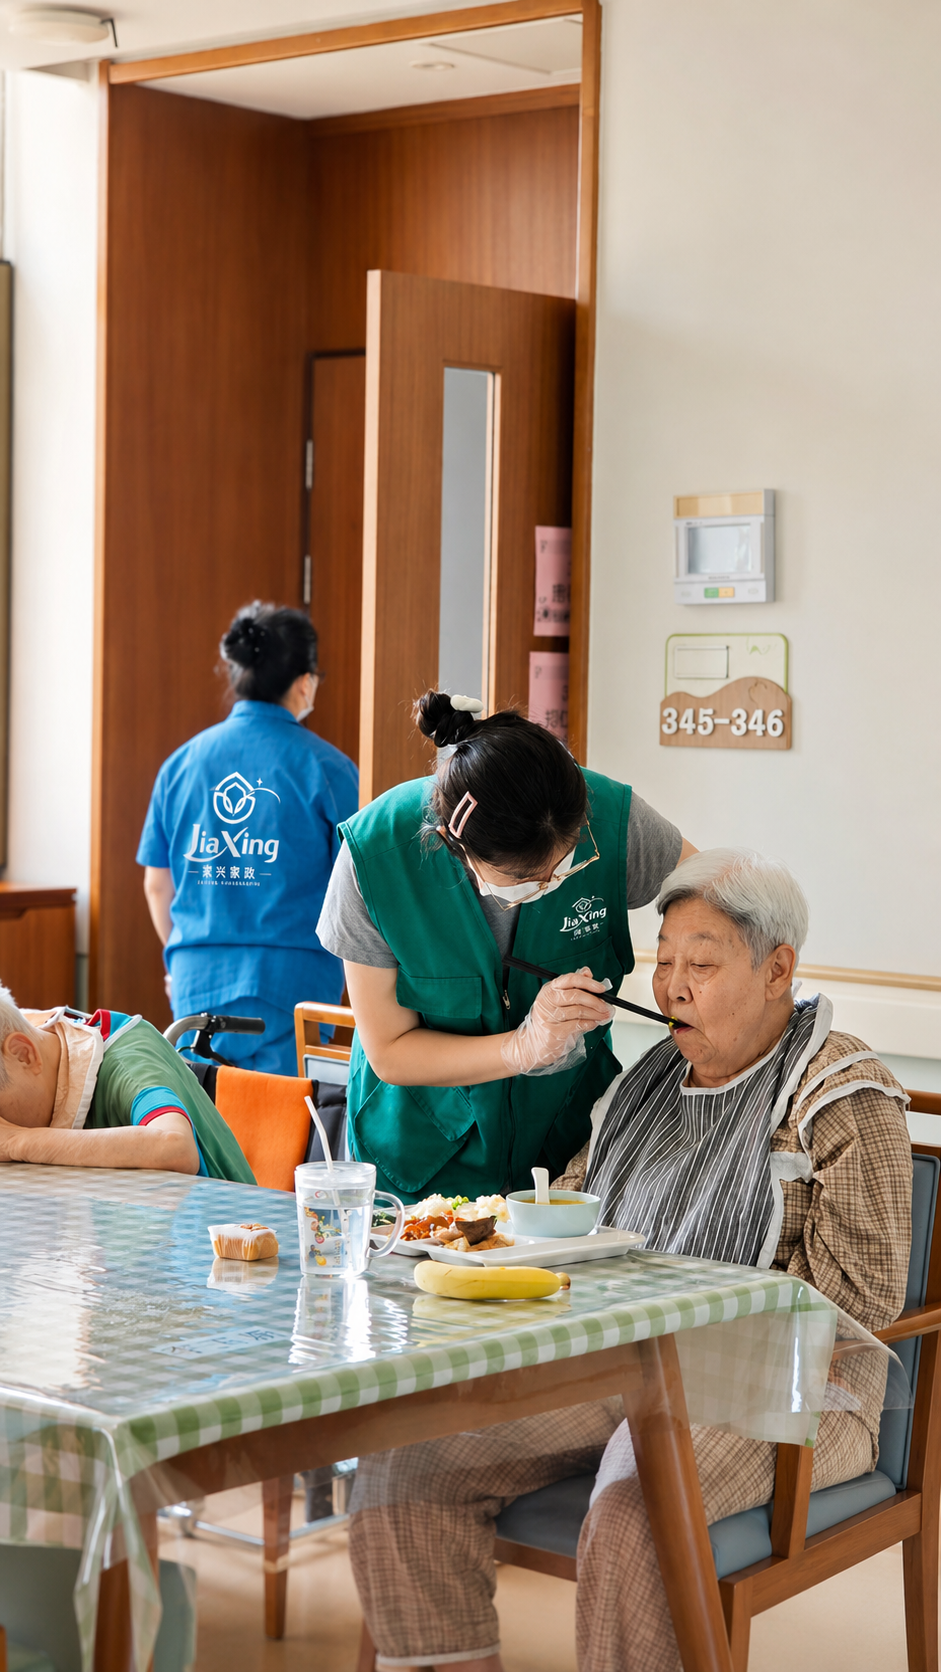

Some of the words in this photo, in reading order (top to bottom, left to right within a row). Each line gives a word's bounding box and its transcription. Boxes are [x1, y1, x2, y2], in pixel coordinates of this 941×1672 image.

[661, 707, 784, 737] 345-346
[183, 824, 280, 863] JiaXing
[560, 907, 607, 932] JiaXing
